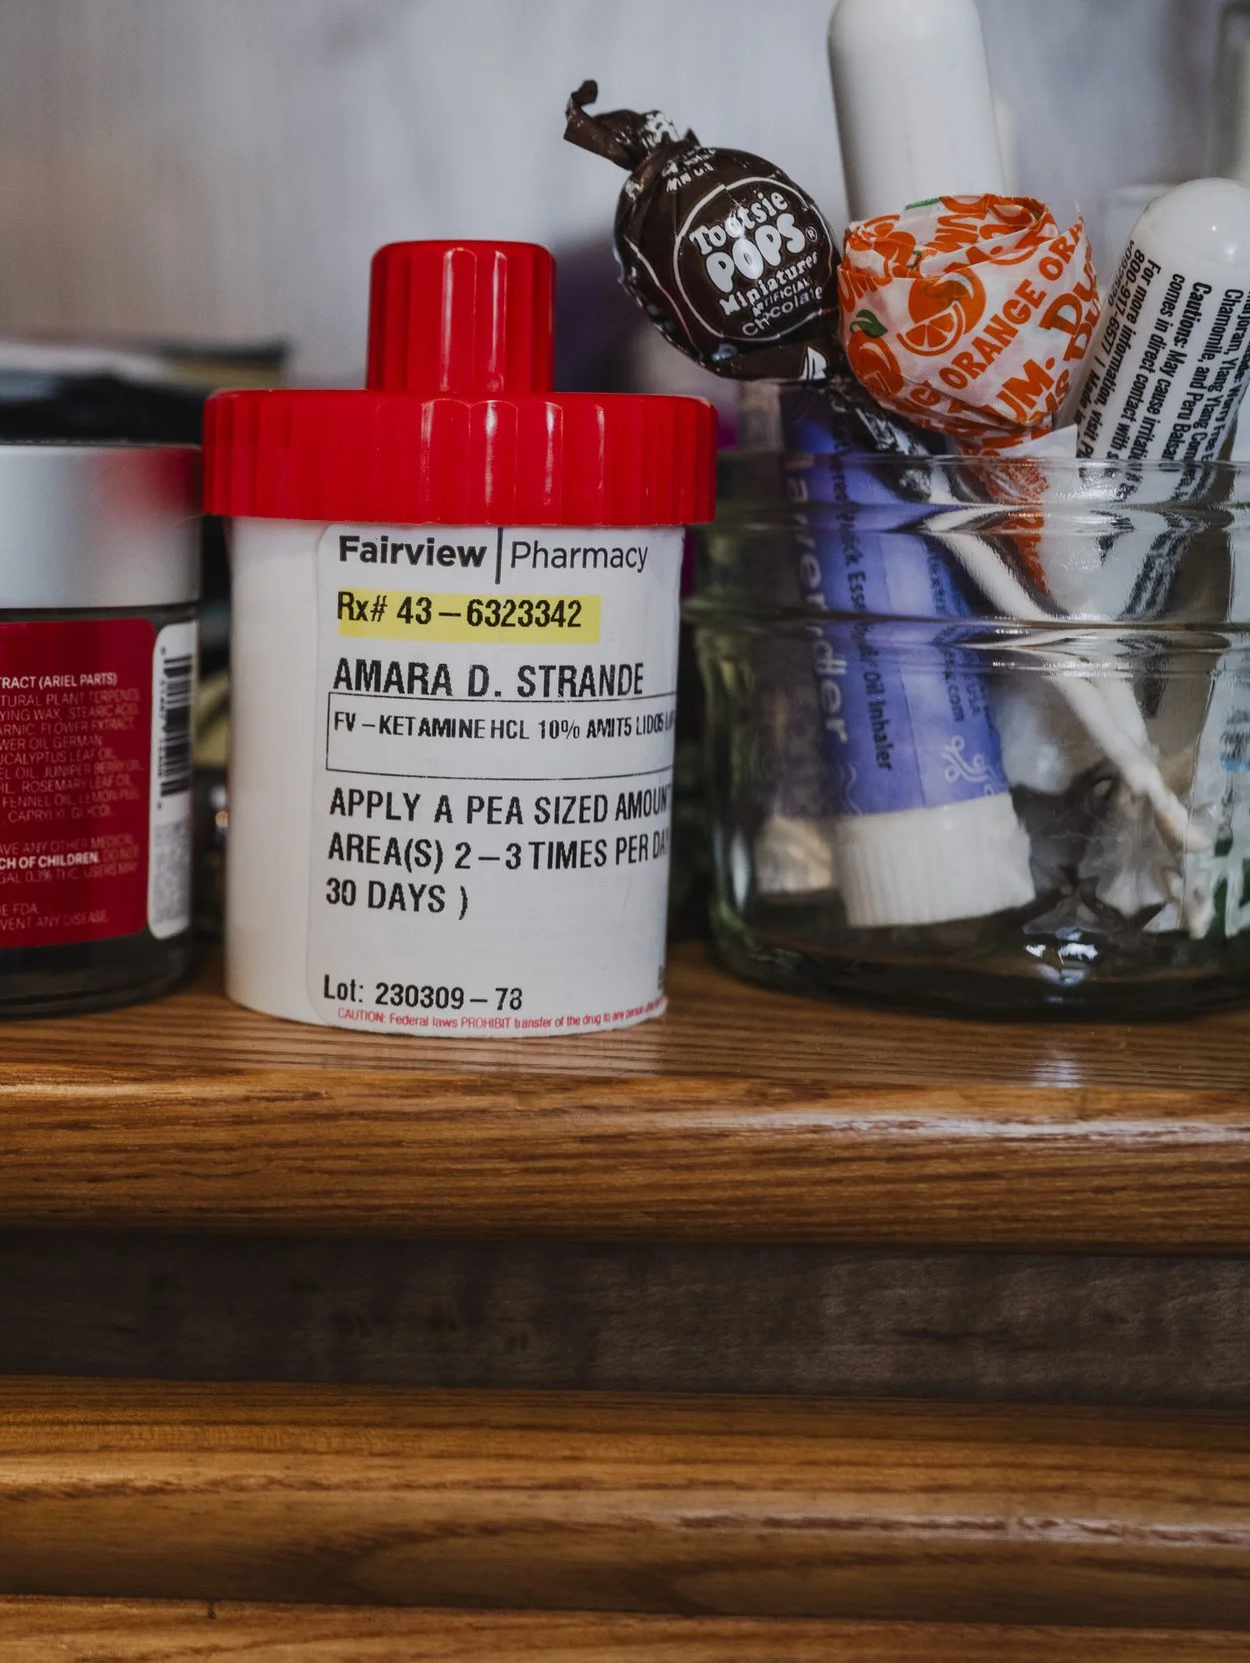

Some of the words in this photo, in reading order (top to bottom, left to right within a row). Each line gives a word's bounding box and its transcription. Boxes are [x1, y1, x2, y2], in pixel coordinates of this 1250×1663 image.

[689, 191, 789, 255] Tootsie
[719, 251, 819, 316] Miniatures
[1144, 257, 1162, 286] For
[1104, 248, 1147, 357] 800-917-6577
[1126, 285, 1148, 326] more
[1160, 273, 1186, 316] comes
[1173, 281, 1213, 348] Cautions:
[938, 278, 1048, 391] ORANGE
[1139, 332, 1168, 376] direct
[1097, 327, 1137, 405] information,
[1162, 348, 1188, 380] May
[1124, 376, 1148, 417] contact
[1151, 378, 1172, 417] cause
[339, 535, 488, 569] Fairview
[510, 539, 649, 573] Pharmacy
[337, 590, 388, 624] Rx#
[38, 674, 78, 691] (ARIEL
[79, 672, 118, 687] PARTS)
[332, 656, 453, 696] AMARA
[467, 661, 502, 697] D.
[516, 661, 644, 699] STRANDE
[489, 718, 530, 741] HCL
[537, 720, 581, 742] 10%
[868, 700, 894, 771] Inhaler
[329, 787, 422, 823] APPLY
[433, 794, 454, 824] A
[466, 795, 524, 826] PEA
[533, 793, 608, 826] SIZED
[17, 856, 38, 870] OF
[327, 831, 444, 875] AREA(S)
[527, 838, 608, 870] TIMES
[614, 838, 650, 866] PER
[326, 877, 356, 907] 30
[368, 880, 446, 914] DAYS
[458, 885, 468, 920] )
[323, 973, 364, 1004] Lot:
[337, 1007, 387, 1025] CAUTION:
[389, 1012, 428, 1028] Federal
[432, 1015, 458, 1029] laws
[460, 1017, 511, 1030] PROHIBIT
[514, 1015, 552, 1029] transfer
[555, 1015, 565, 1028] of
[566, 1014, 581, 1028] the
[583, 1013, 601, 1027] drug
[604, 1011, 611, 1023] to
